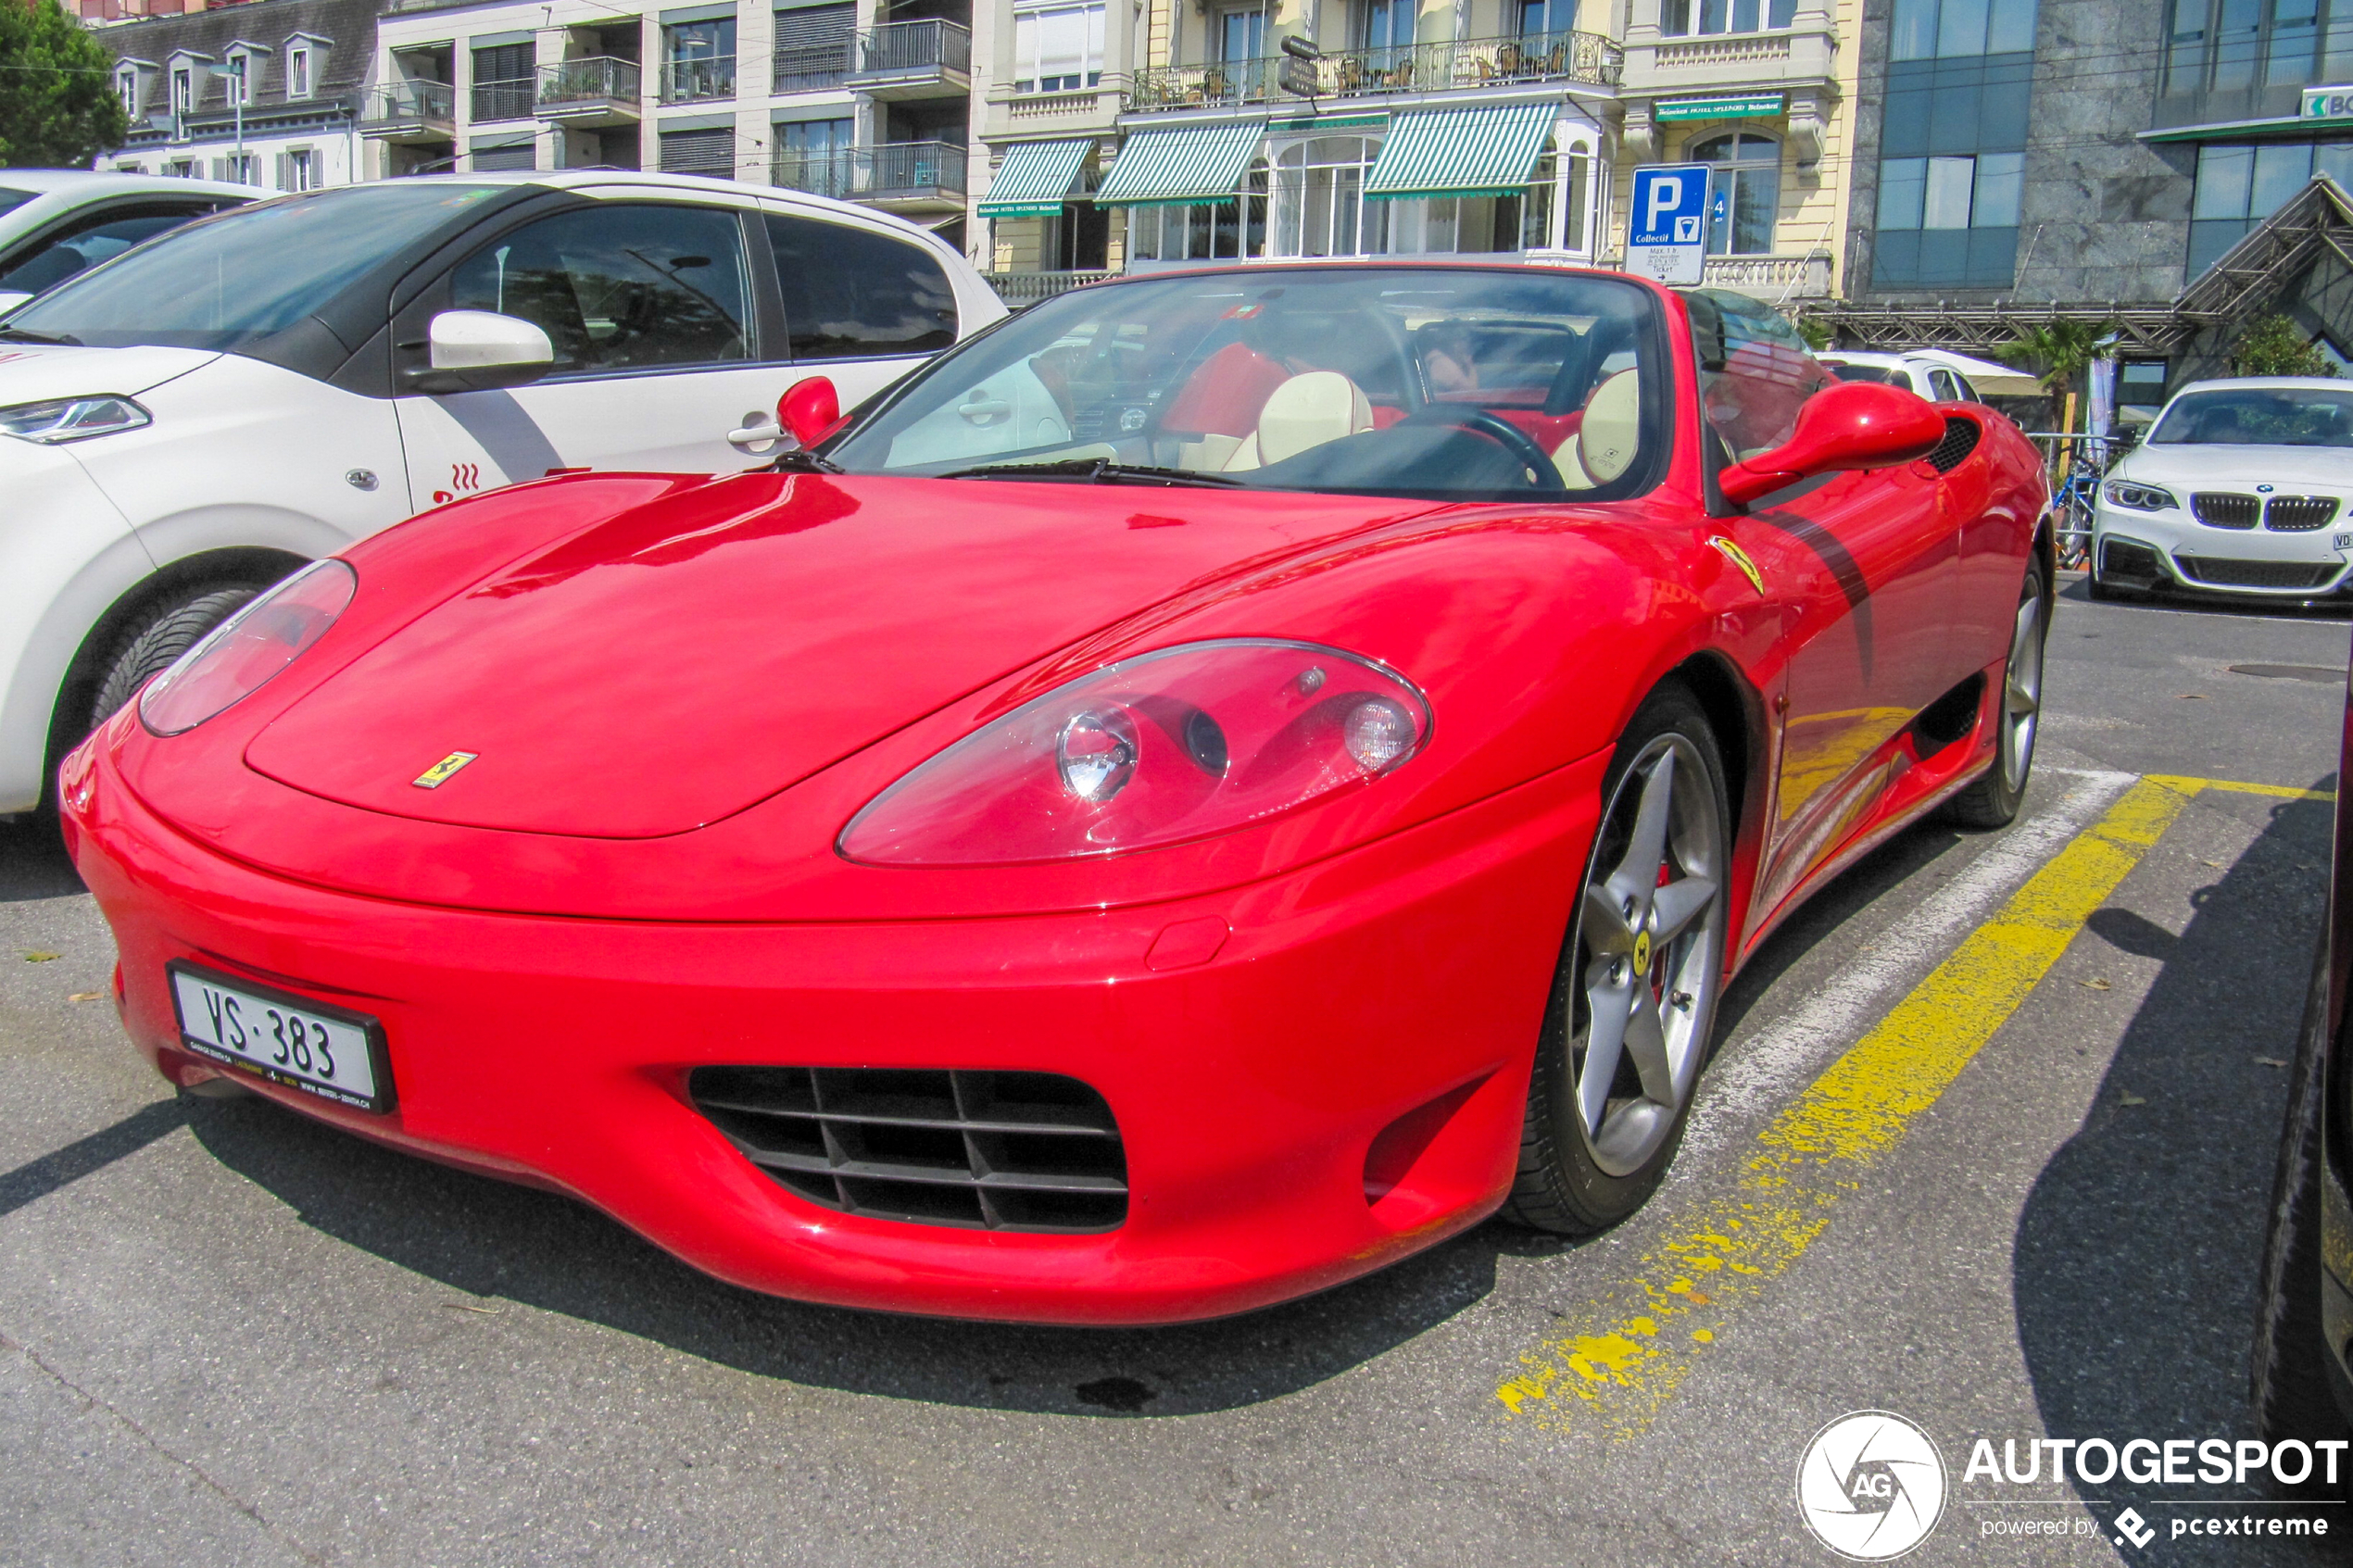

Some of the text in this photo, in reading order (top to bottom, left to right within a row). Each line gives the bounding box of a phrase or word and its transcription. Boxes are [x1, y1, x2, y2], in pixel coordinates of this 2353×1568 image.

[1289, 70, 1316, 85] SPLENDID
[1747, 102, 1780, 111] Heineken
[1646, 177, 1682, 232] P
[1635, 233, 1669, 244] Collectif
[1653, 265, 1673, 273] Ticket
